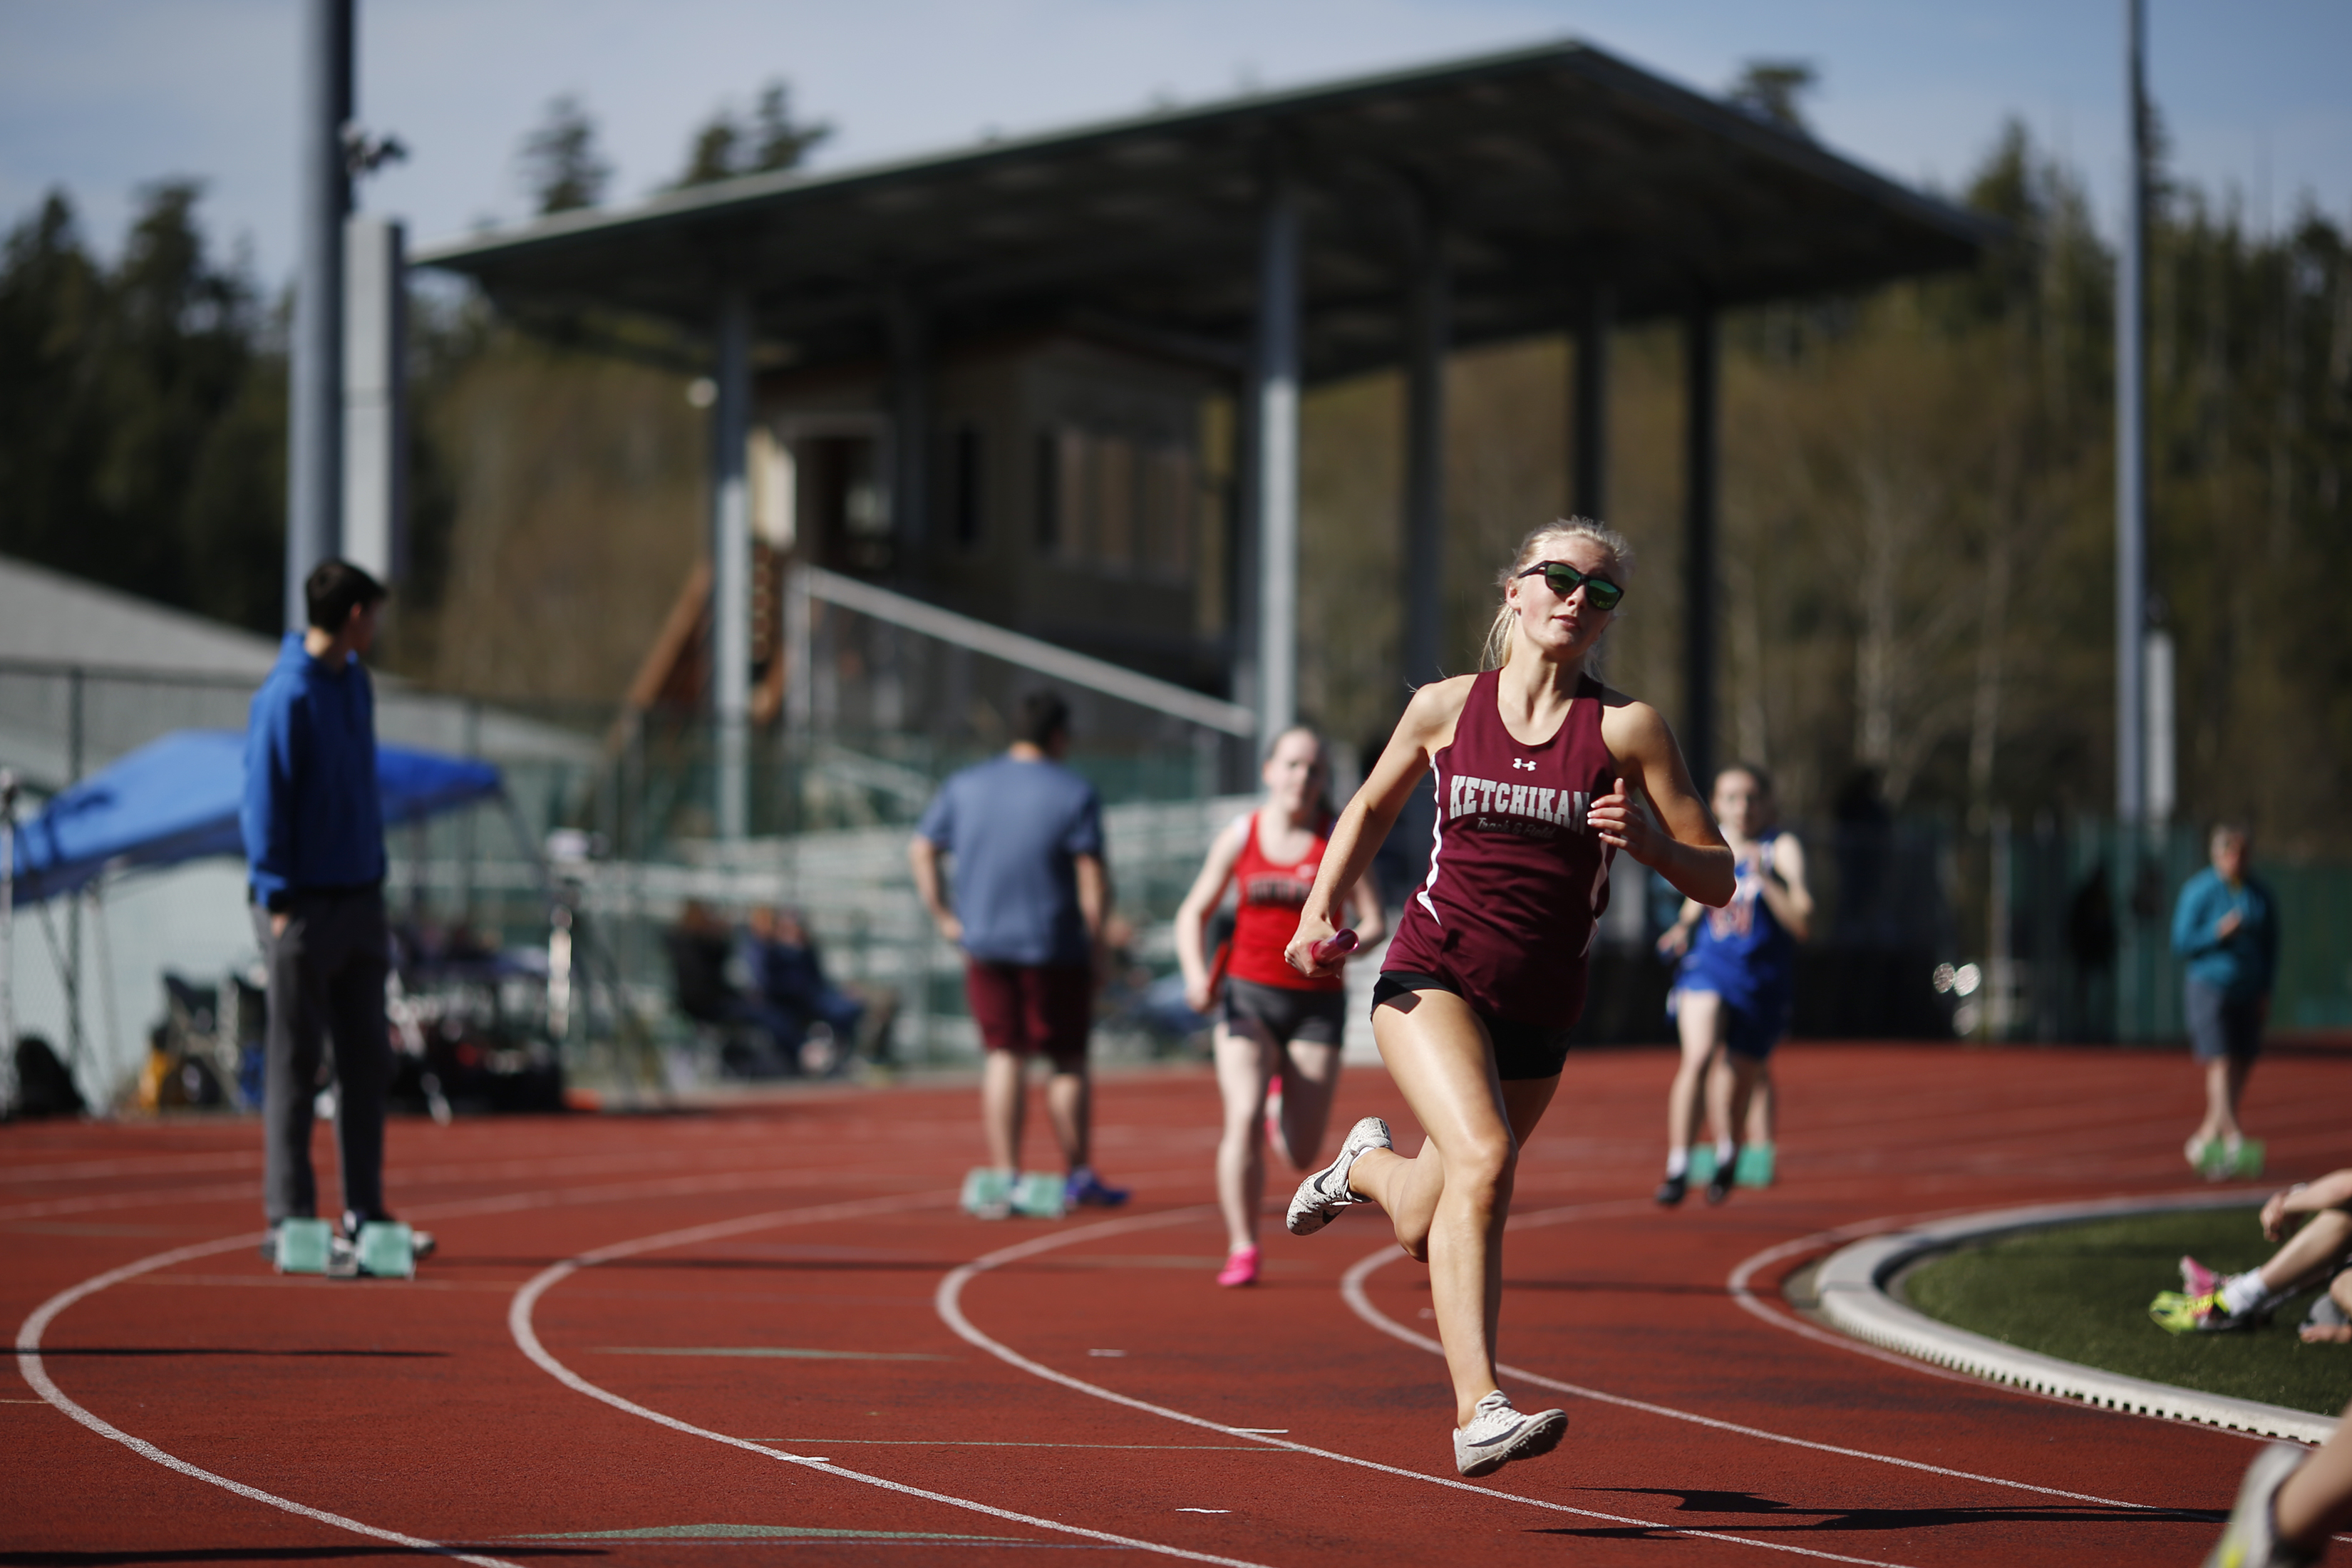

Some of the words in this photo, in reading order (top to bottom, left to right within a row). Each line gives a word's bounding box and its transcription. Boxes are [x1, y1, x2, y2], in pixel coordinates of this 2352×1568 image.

[1449, 775, 1590, 835] KETCHIKAN
[1477, 817, 1510, 833] Track
[1512, 822, 1522, 835] &
[1524, 824, 1557, 839] Field
